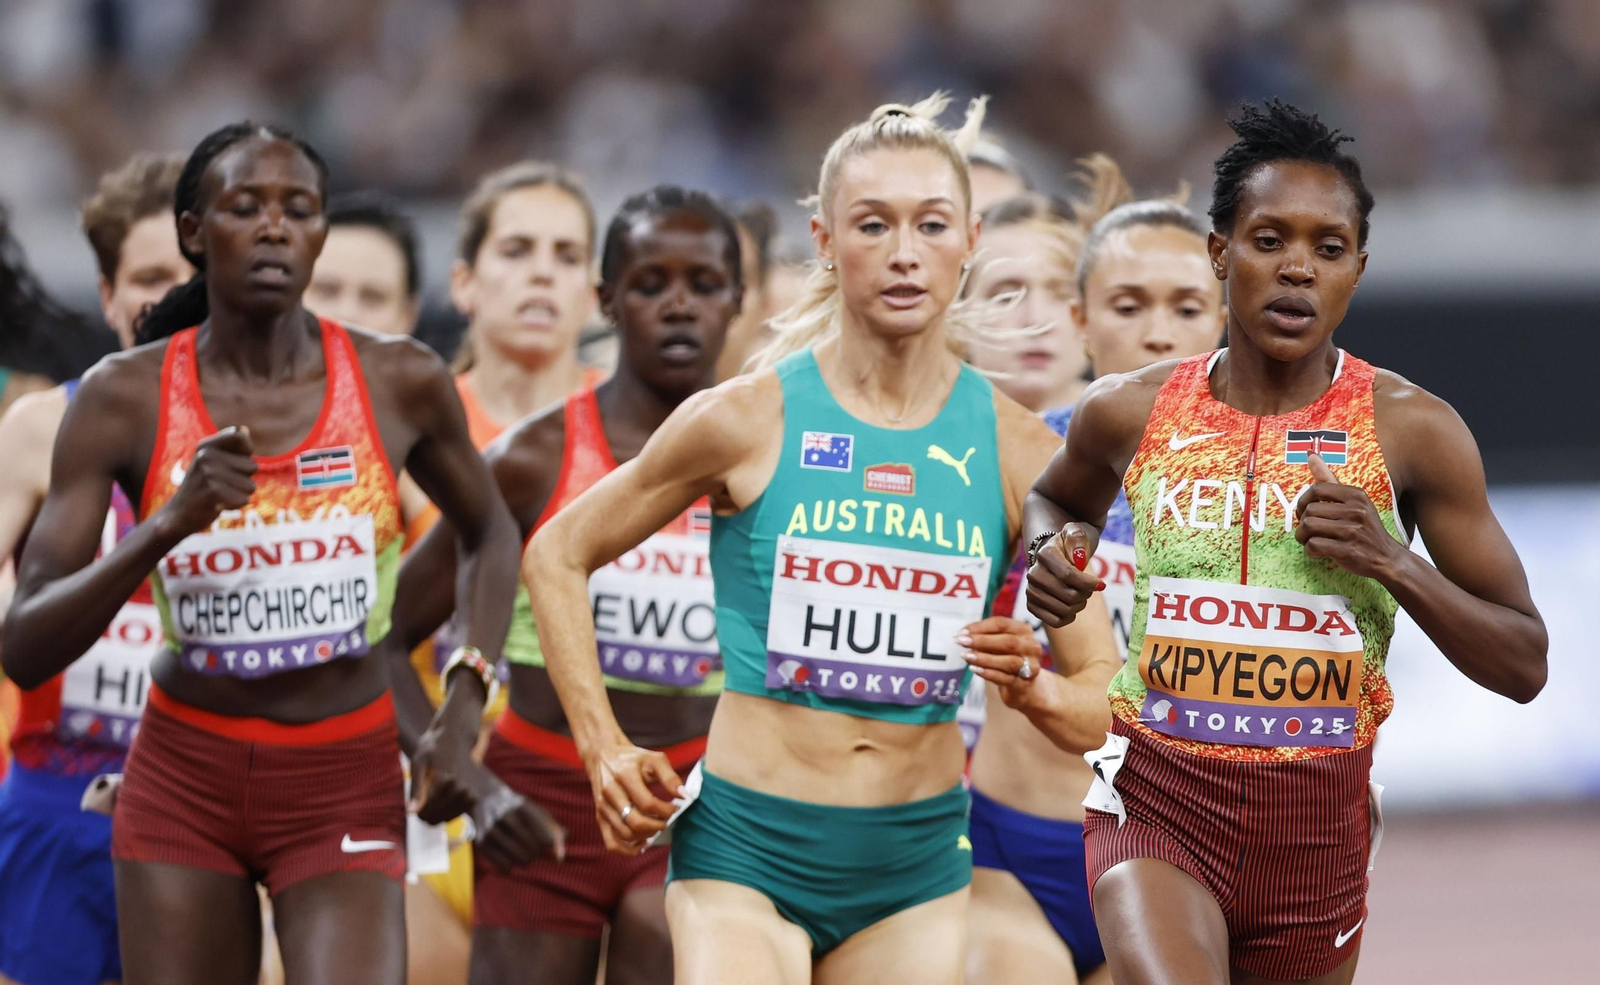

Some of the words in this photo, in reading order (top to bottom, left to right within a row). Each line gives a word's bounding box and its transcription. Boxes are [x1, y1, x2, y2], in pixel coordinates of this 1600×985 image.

[786, 499, 986, 558] AUSTRALIA
[1153, 477, 1310, 533] KENY
[166, 534, 366, 578] HONDA
[780, 553, 981, 599] HONDA
[178, 577, 369, 636] CHEPCHIRCHIR
[594, 593, 716, 643] EWO
[1152, 592, 1356, 637] HONDA
[803, 605, 947, 661] HULL
[95, 664, 143, 706] HI
[1149, 643, 1352, 701] KIPYEGON
[1310, 716, 1345, 736] 25
